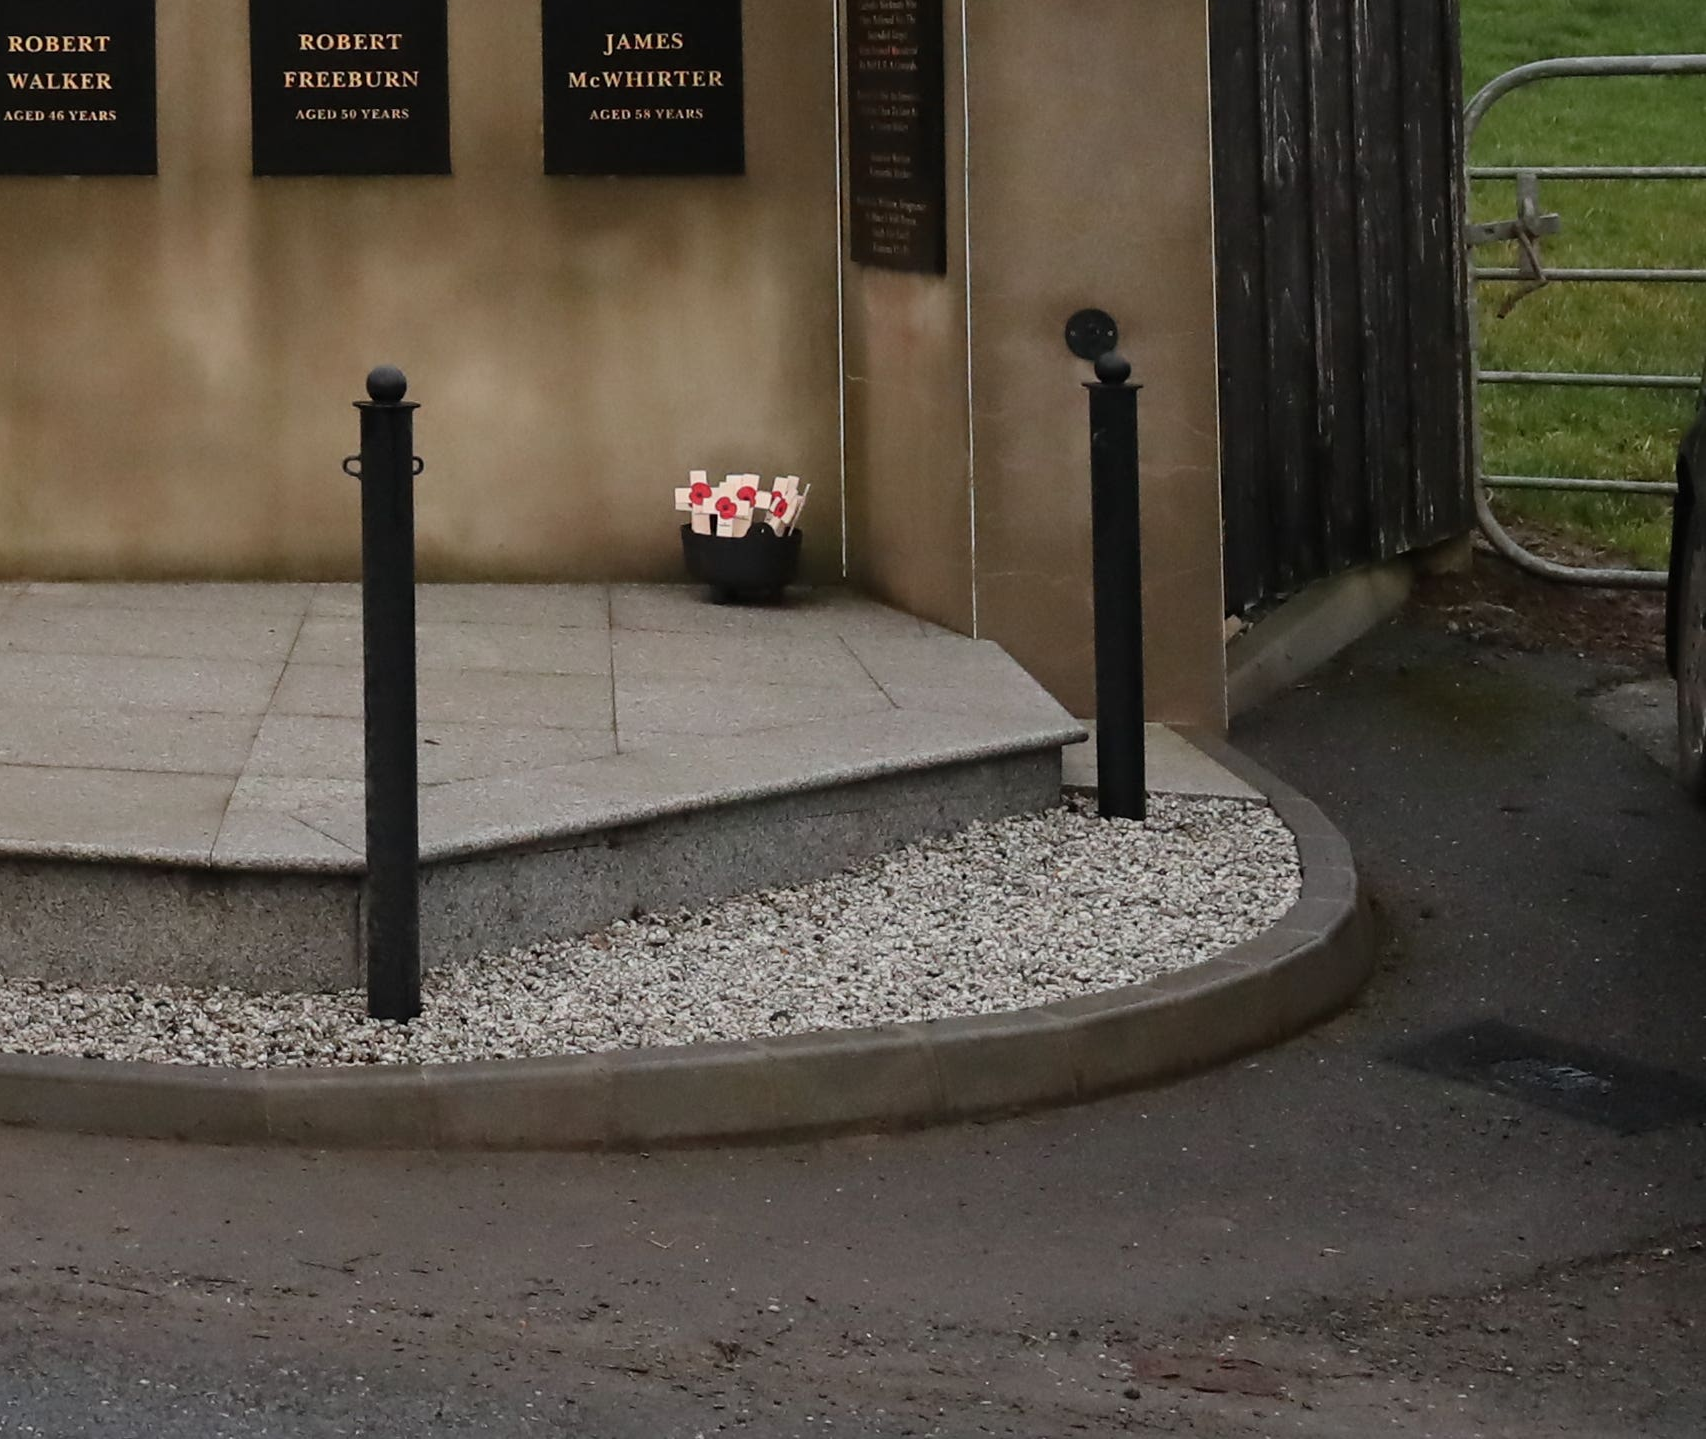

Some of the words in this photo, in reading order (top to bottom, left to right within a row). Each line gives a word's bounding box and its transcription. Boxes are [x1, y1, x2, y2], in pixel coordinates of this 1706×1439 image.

[8, 36, 110, 52] ROBERT
[298, 34, 402, 50] ROBERT
[603, 33, 683, 55] JAMES
[7, 73, 112, 89] WALKER
[284, 71, 419, 88] FREEBURN
[569, 71, 723, 88] McWHIRTER
[4, 110, 45, 121] AGED
[49, 111, 64, 120] 46
[69, 110, 116, 121] YEARS
[296, 109, 336, 119] AGED
[342, 109, 357, 119] 50
[361, 109, 409, 119] YEARS
[590, 109, 631, 120] AGED
[635, 109, 650, 119] 58
[656, 109, 703, 119] YEARS
